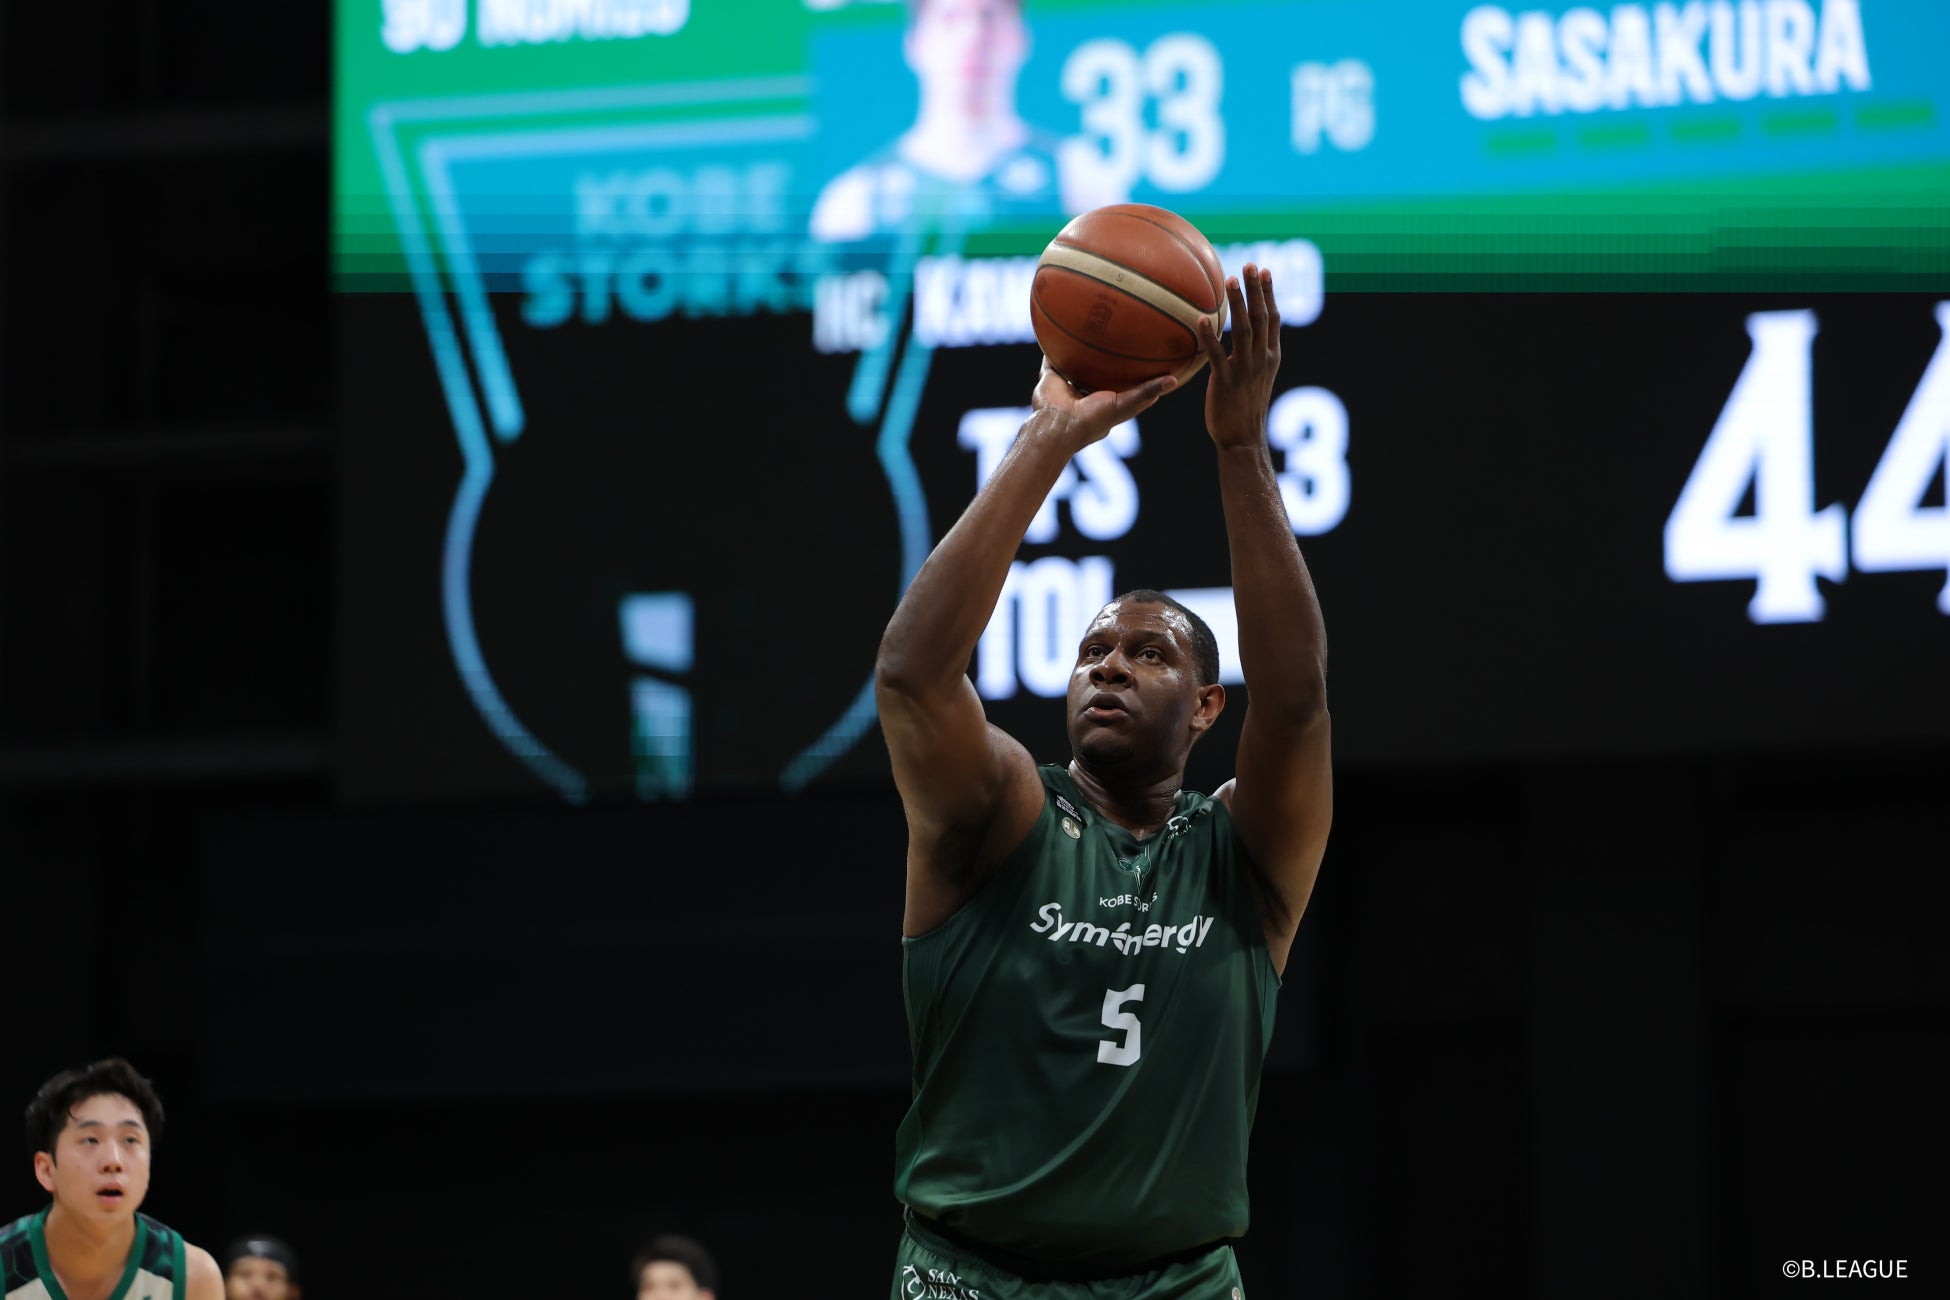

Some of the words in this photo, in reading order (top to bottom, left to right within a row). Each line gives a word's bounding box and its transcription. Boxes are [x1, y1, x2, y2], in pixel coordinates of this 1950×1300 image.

[1060, 33, 1226, 191] 33
[1291, 58, 1377, 154] PG
[1459, 0, 1872, 120] SASAKURA
[1267, 386, 1352, 536] 3
[1663, 299, 1950, 624] 44
[1099, 894, 1132, 908] KOBE
[1097, 983, 1145, 1067] 5
[927, 1268, 962, 1285] SAN
